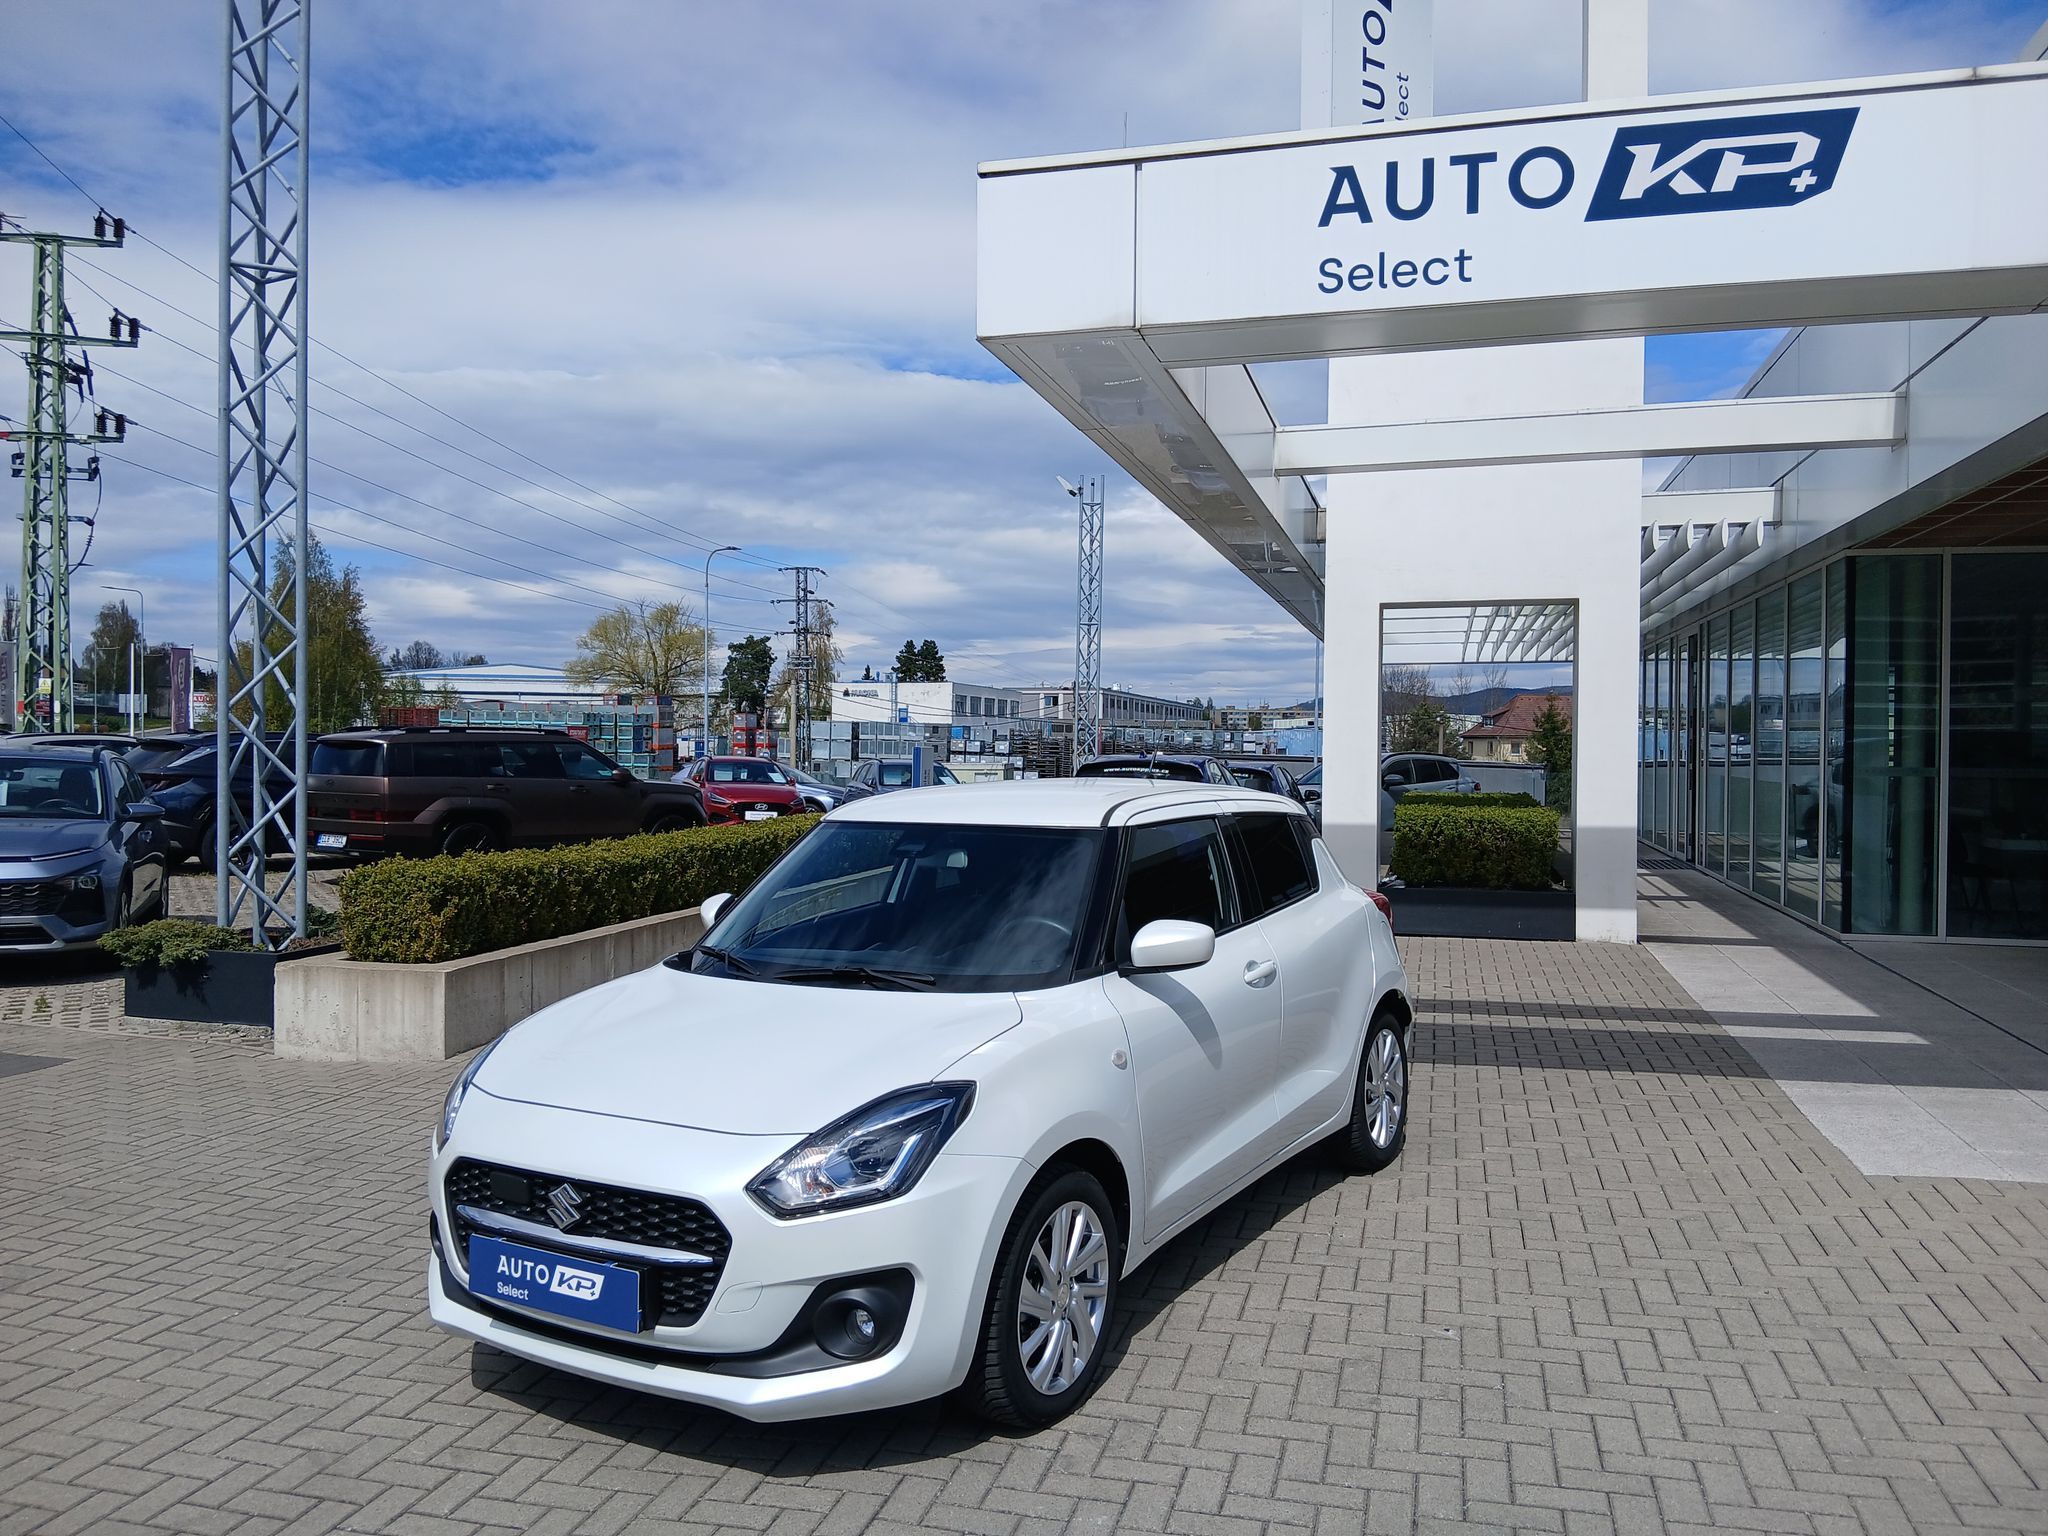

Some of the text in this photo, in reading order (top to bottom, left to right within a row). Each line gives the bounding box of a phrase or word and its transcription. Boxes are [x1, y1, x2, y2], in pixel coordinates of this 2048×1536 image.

[1361, 9, 1386, 124] UTO
[1317, 145, 1575, 228] AUTO
[1317, 248, 1473, 294] Select
[496, 1254, 550, 1285] AUTO
[496, 1281, 529, 1301] Select
